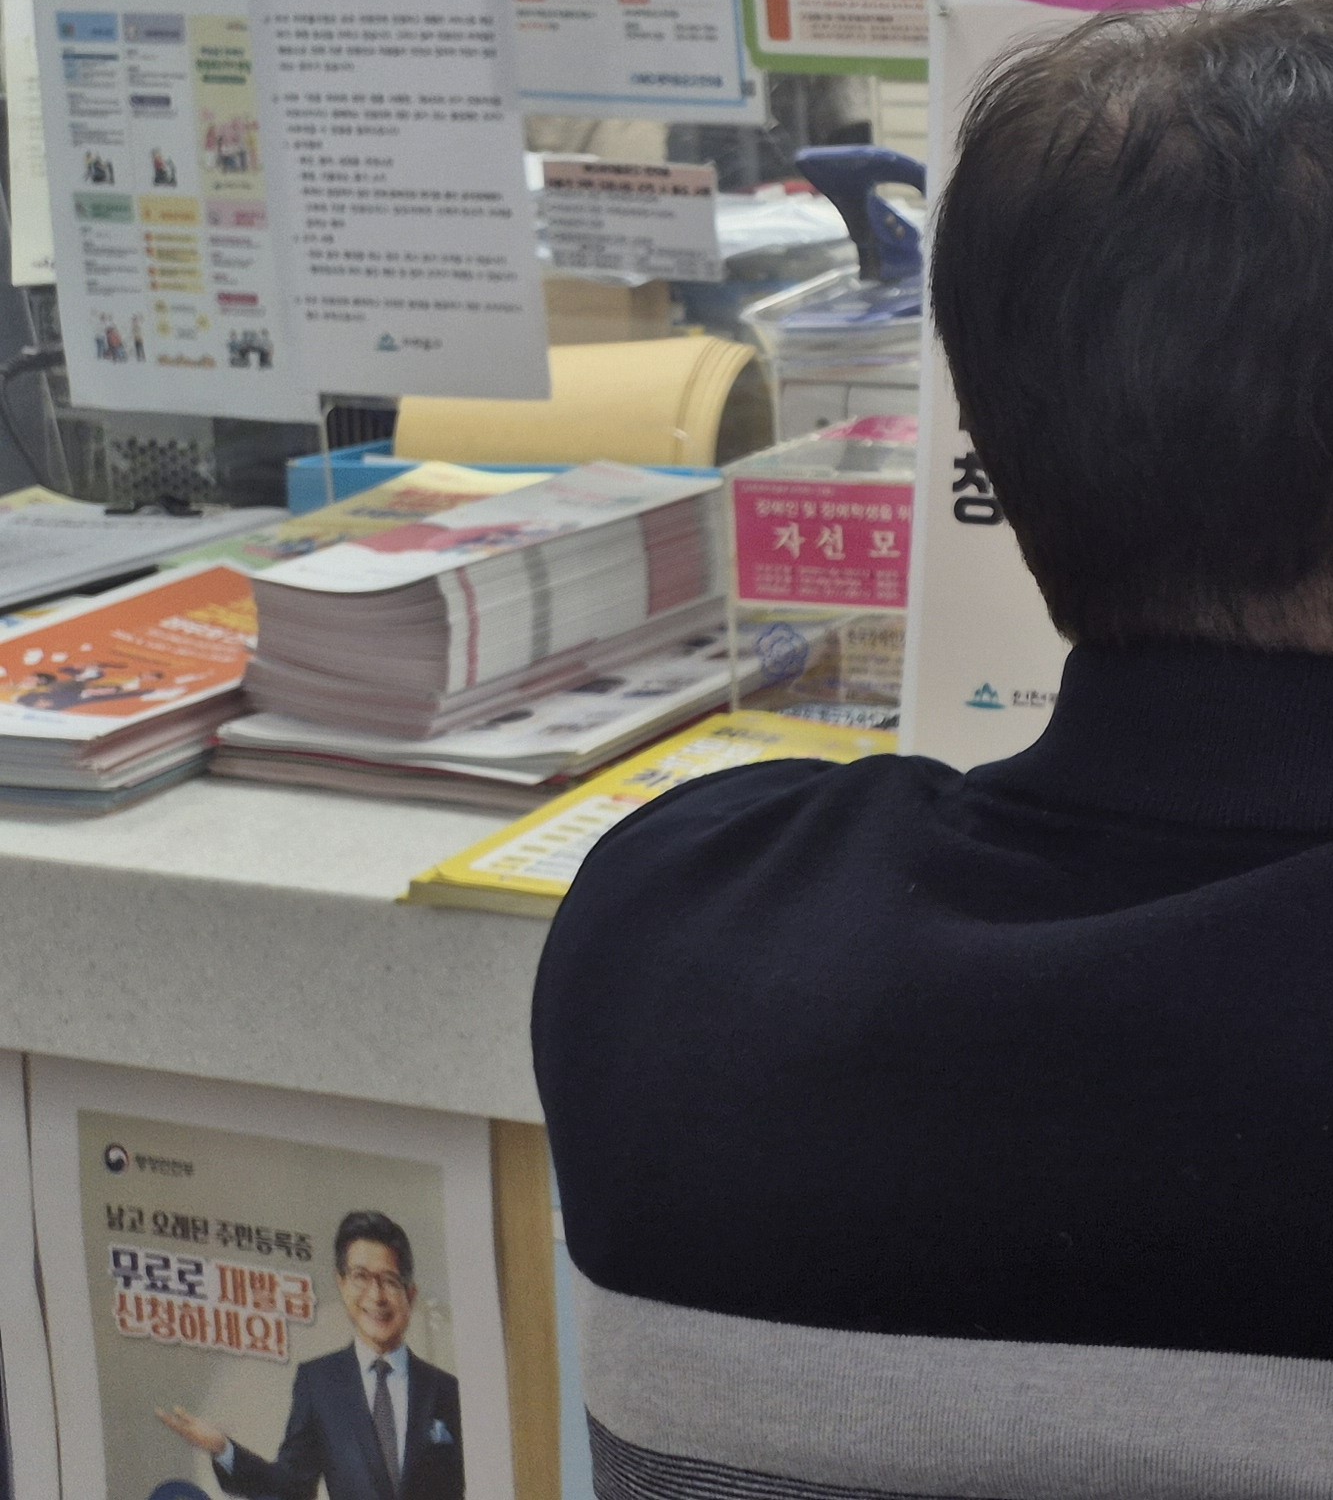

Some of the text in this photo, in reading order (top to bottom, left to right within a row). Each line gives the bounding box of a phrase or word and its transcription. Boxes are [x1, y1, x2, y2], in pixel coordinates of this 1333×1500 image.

[105, 1206, 151, 1234] 낡고
[152, 1210, 210, 1246] 오래된
[111, 1248, 315, 1323] 무료로 재발급
[115, 1293, 287, 1357] 신청하세요!
